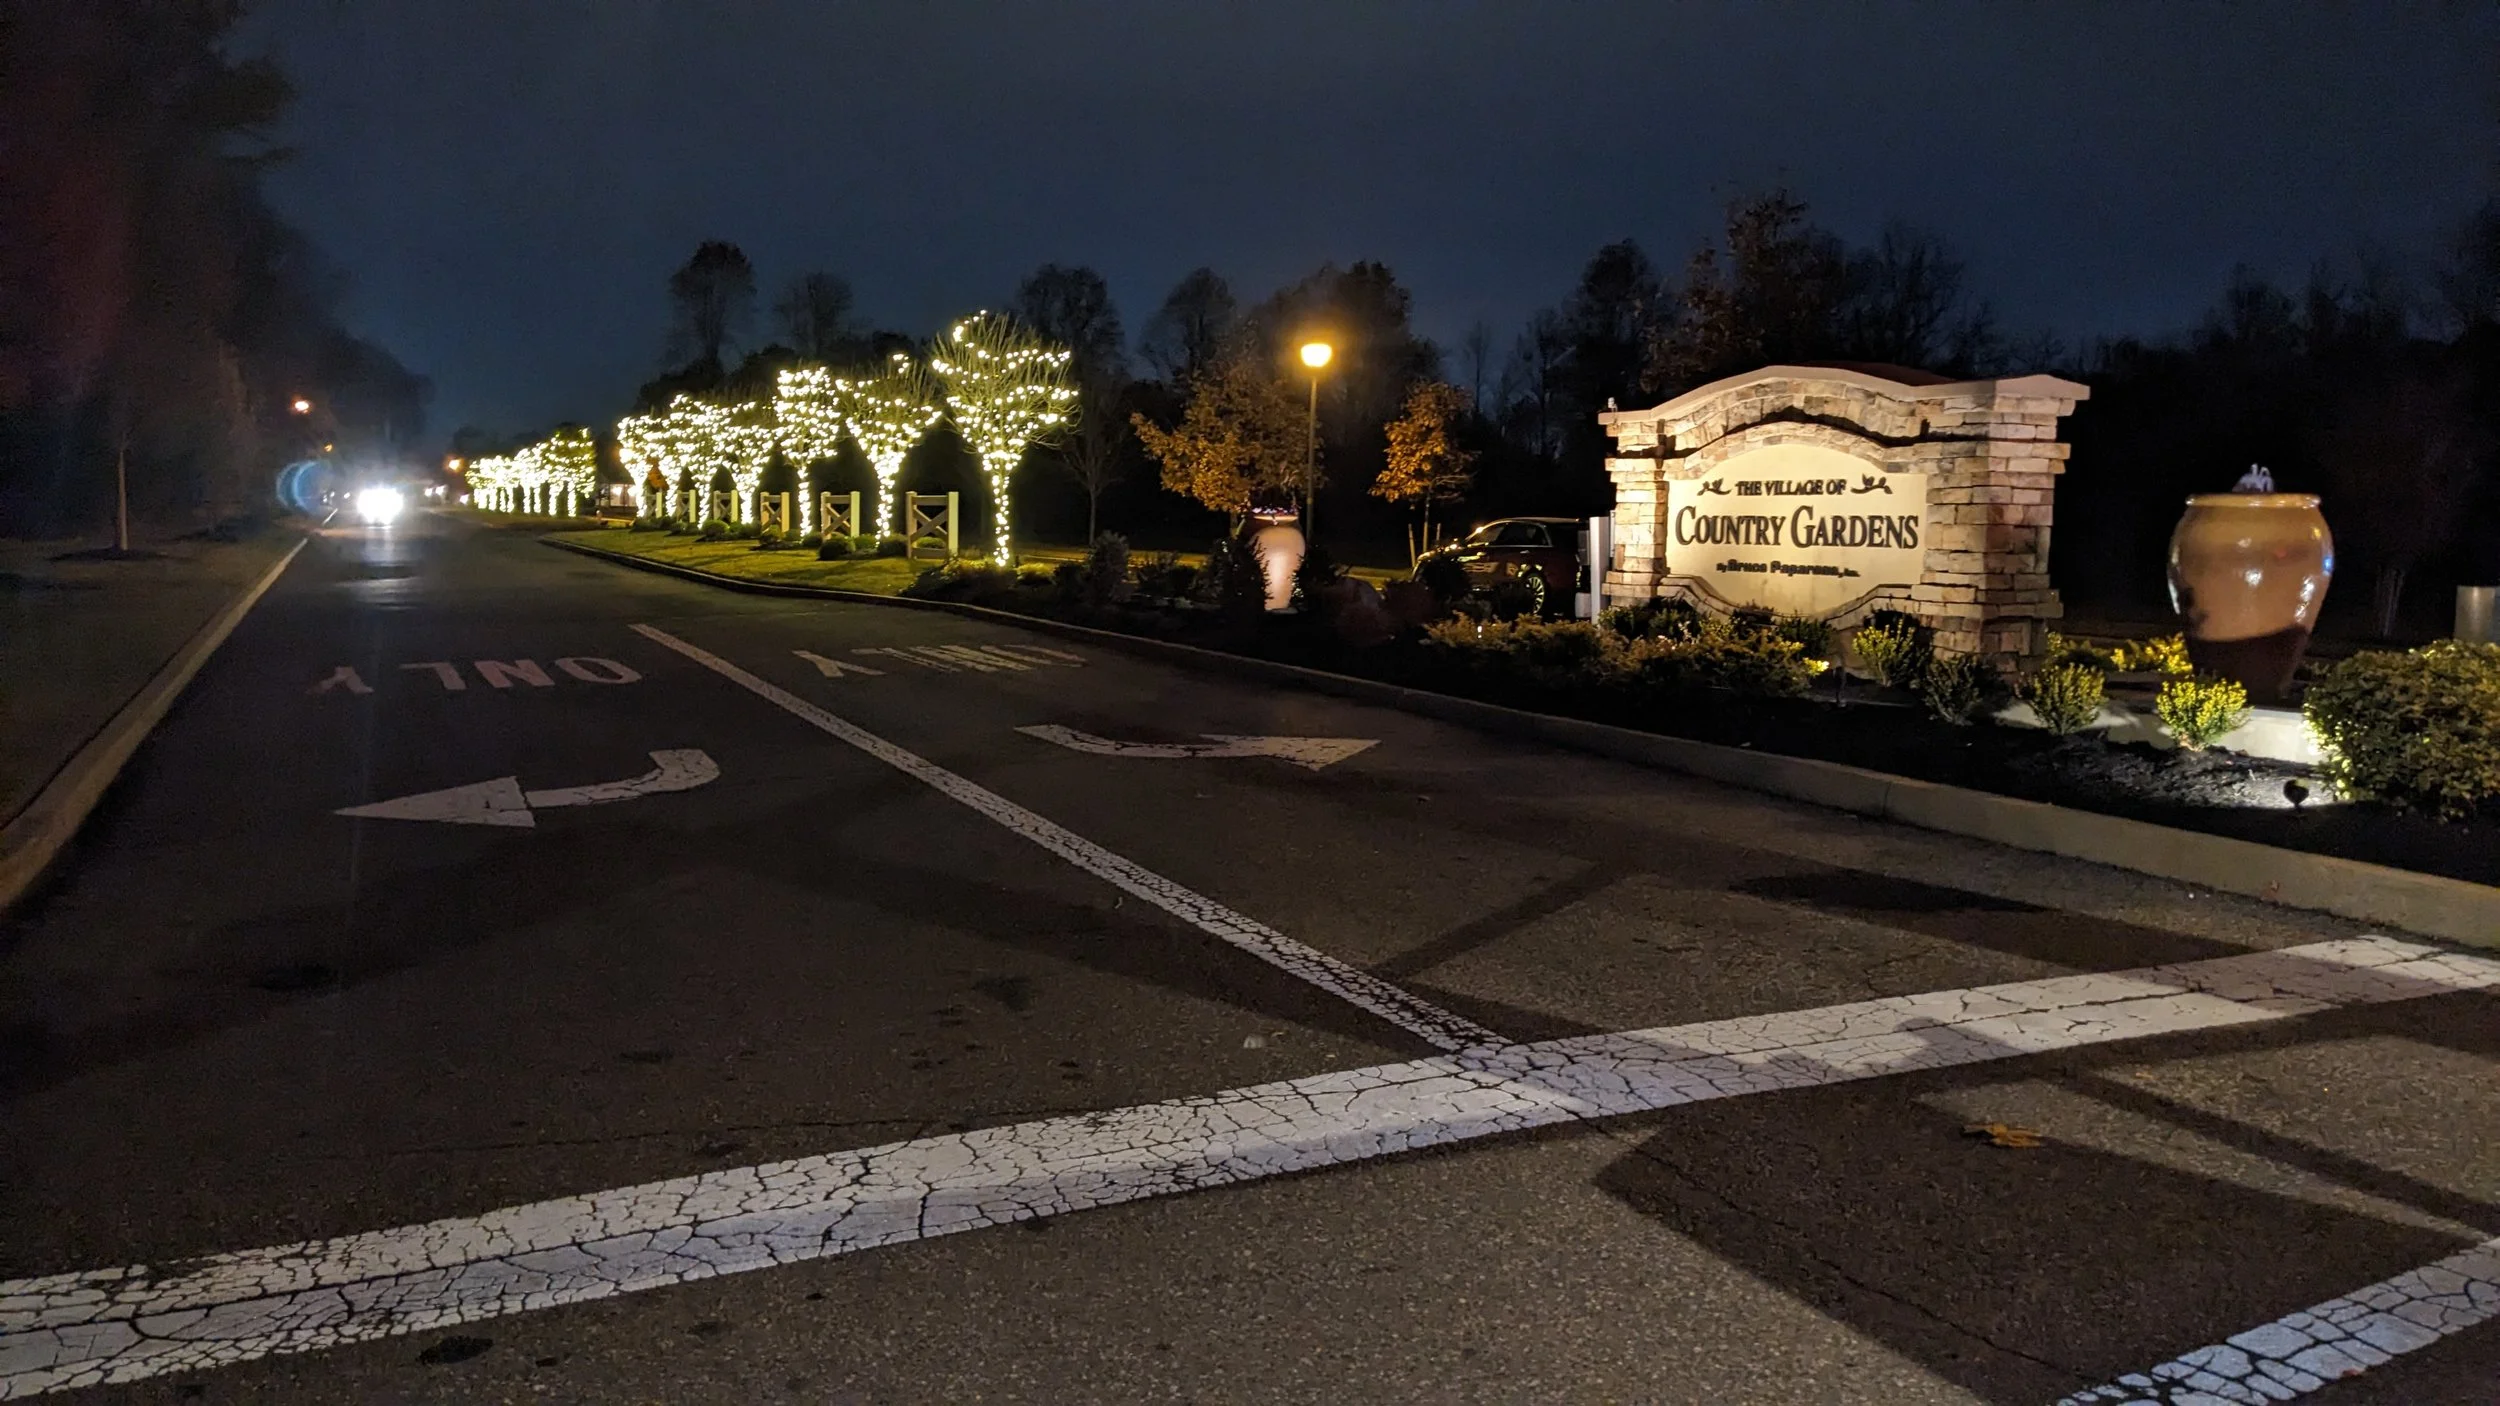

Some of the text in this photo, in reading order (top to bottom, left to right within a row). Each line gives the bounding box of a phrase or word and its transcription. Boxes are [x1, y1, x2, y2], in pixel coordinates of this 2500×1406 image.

[1735, 479, 1847, 496] THE VILLAGE OF
[1675, 505, 1919, 549] COUNTRY GARDENS
[306, 657, 643, 694] ONLY
